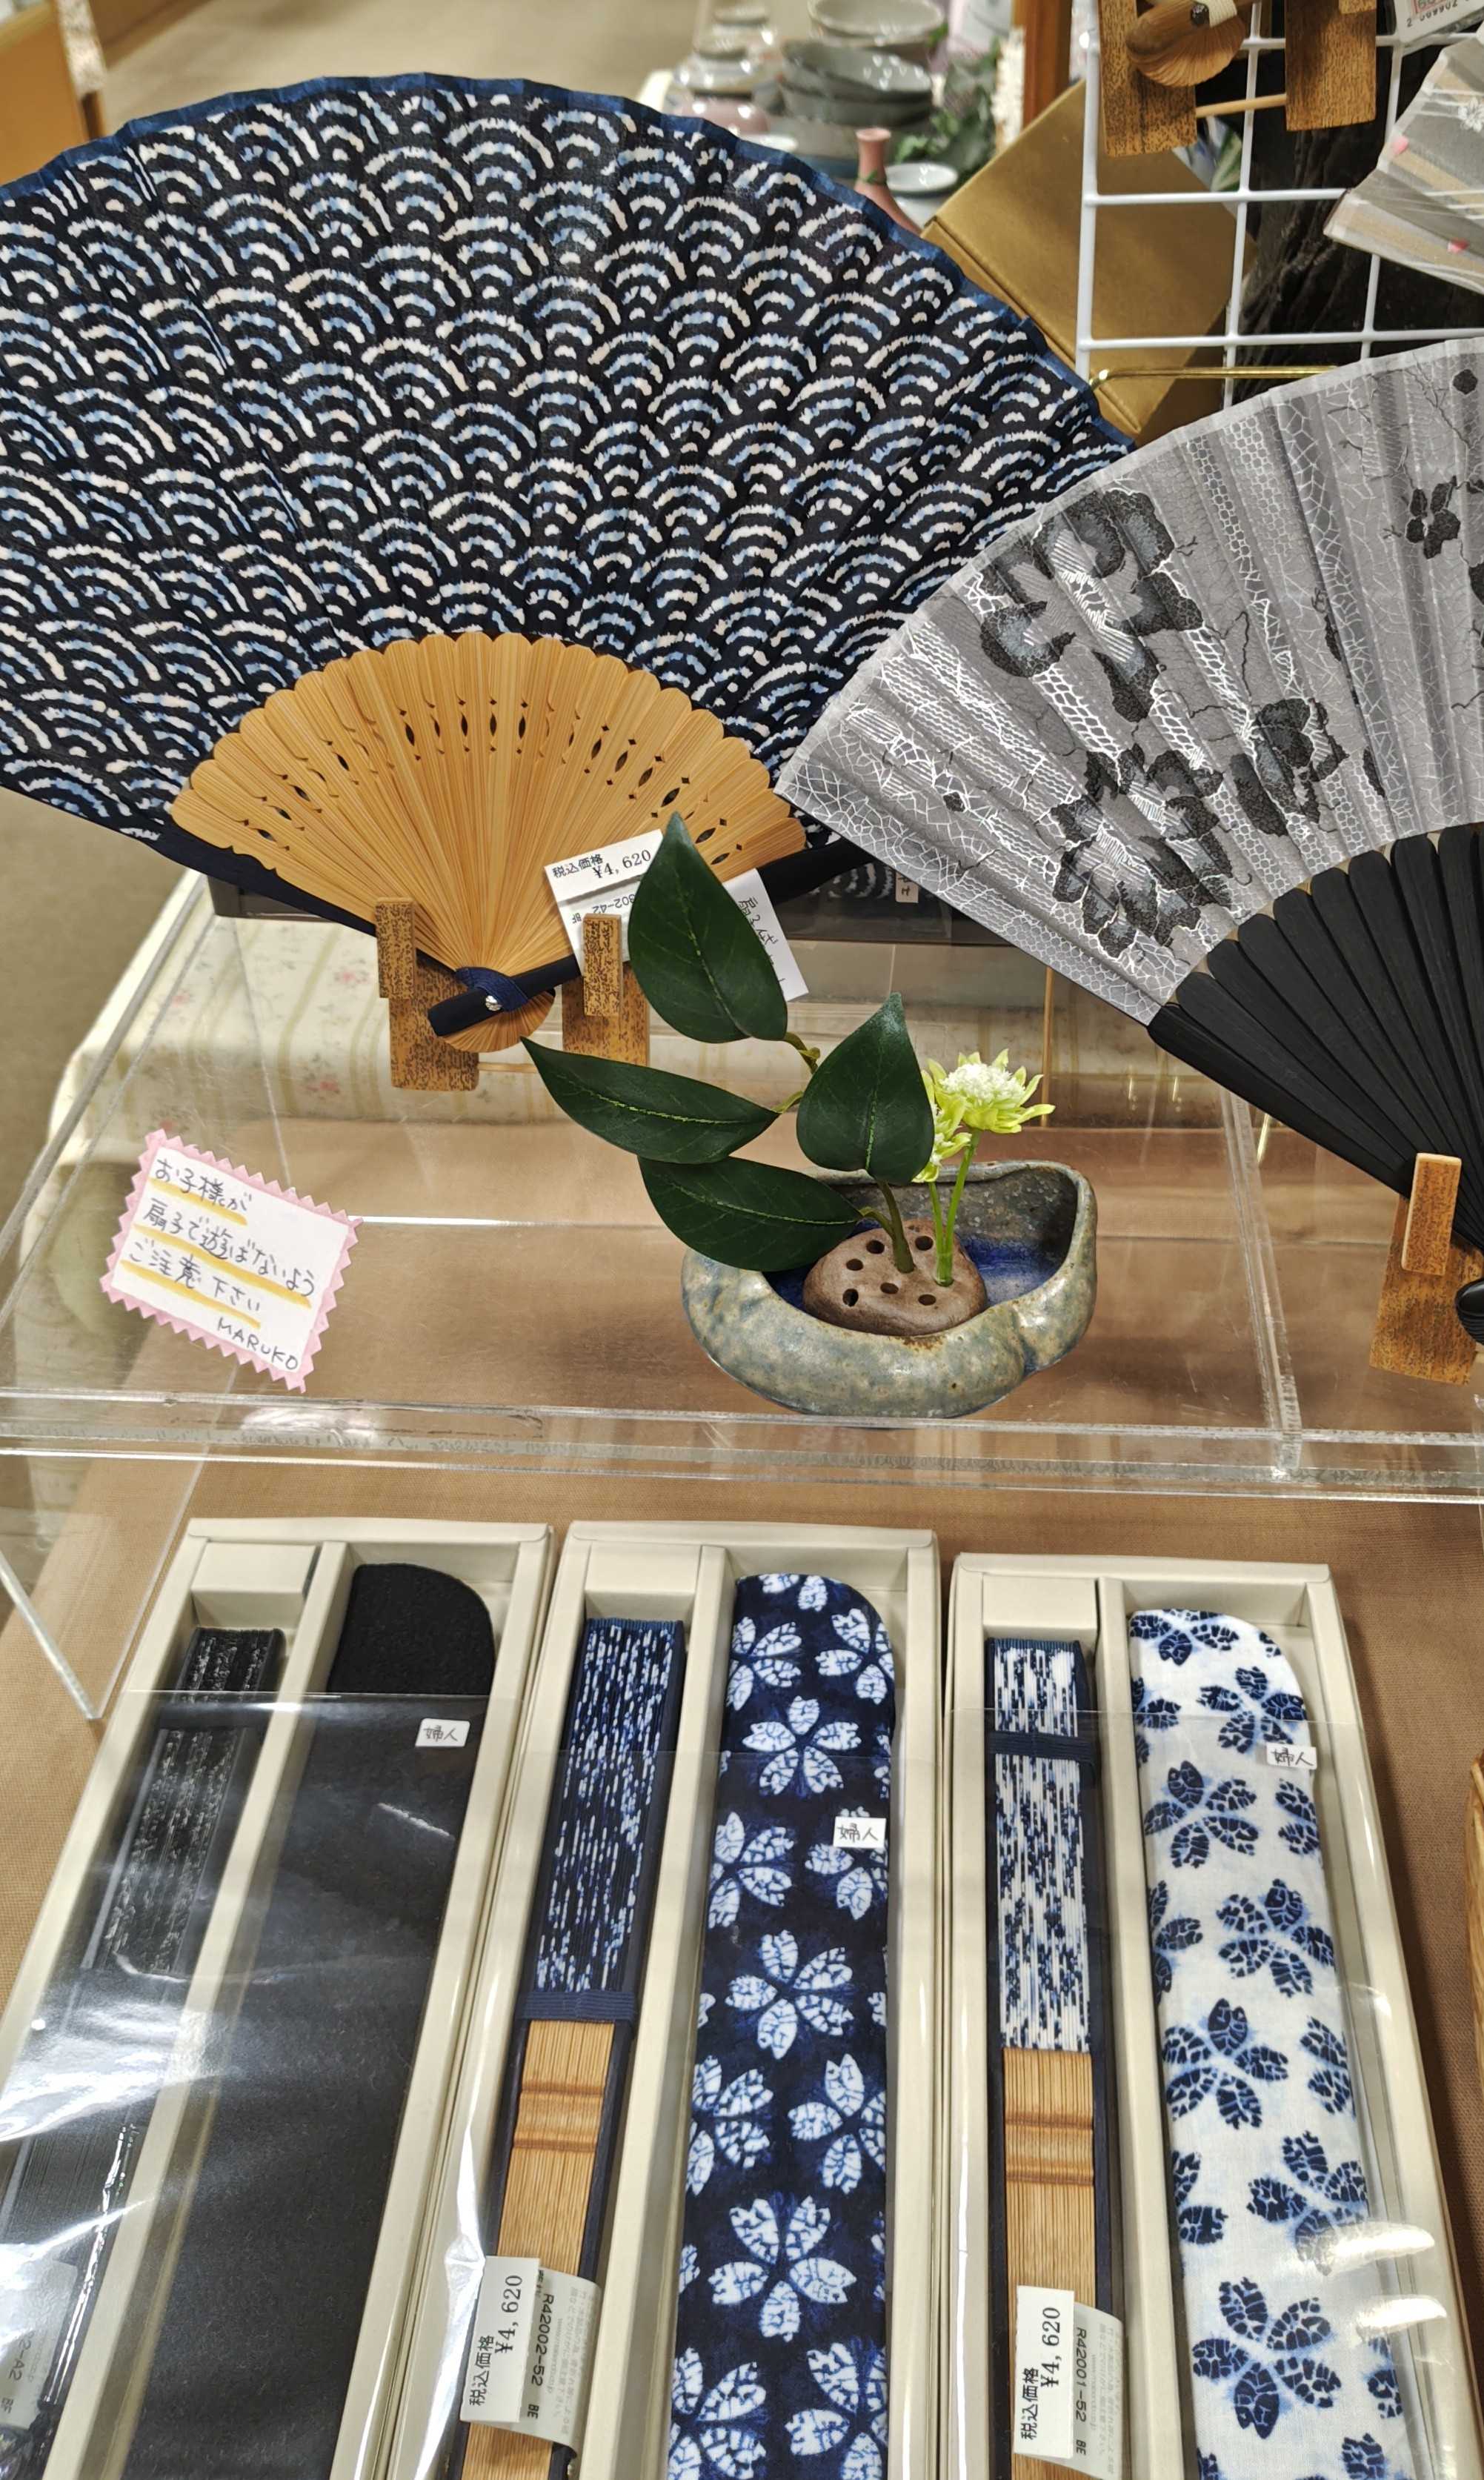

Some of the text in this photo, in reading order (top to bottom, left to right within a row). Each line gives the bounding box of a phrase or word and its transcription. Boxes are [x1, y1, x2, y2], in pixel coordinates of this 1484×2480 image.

[552, 854, 603, 878] 税込価格
[155, 1159, 252, 1212] お子様が
[143, 1197, 315, 1297] 扇子で遊ばないよう
[218, 1317, 299, 1370] MARUKO
[423, 1725, 458, 1742] 婦人
[1271, 1747, 1314, 1766] 婦人
[836, 1823, 879, 1843] 婦人
[531, 2293, 554, 2387] R42002-52
[469, 2335, 494, 2406] 税込価格
[1076, 2327, 1087, 2456] R42001-52 BE
[528, 2404, 539, 2419] BE
[1021, 2367, 1039, 2440] 税込価格
